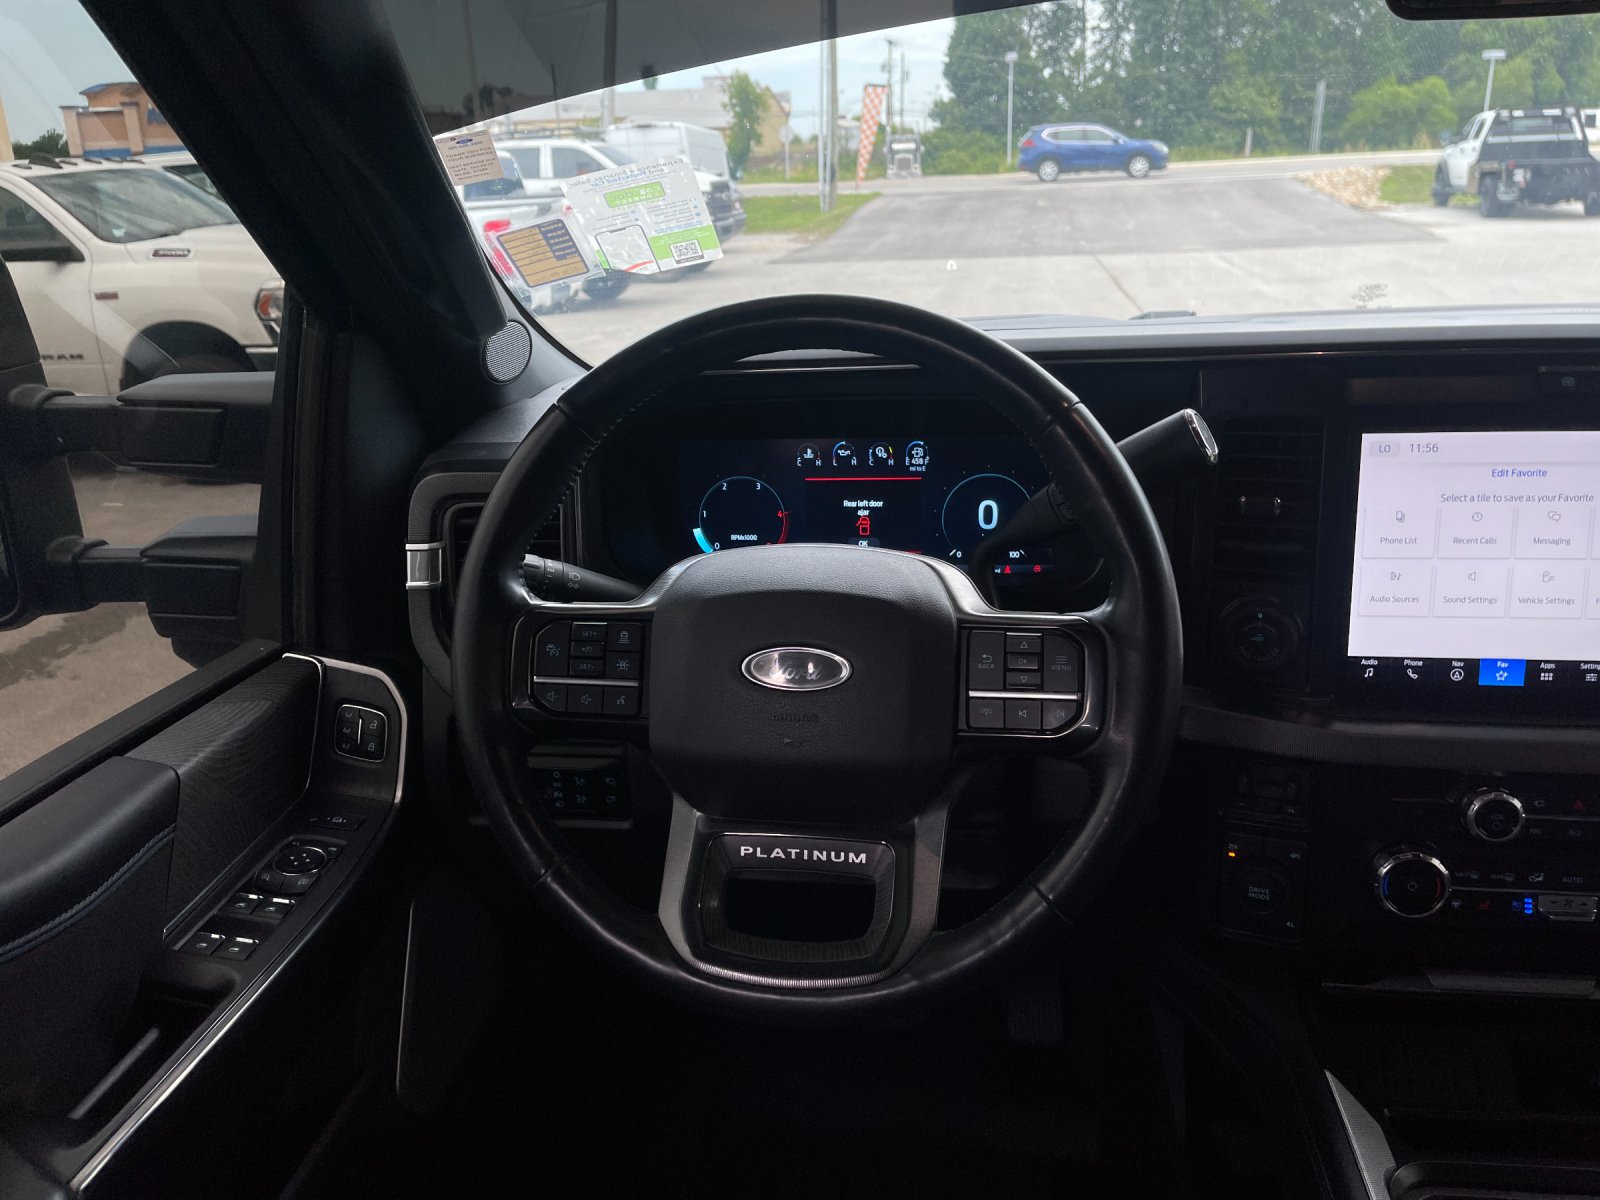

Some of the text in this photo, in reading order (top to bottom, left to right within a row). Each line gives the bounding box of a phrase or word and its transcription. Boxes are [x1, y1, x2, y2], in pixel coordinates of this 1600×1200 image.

[1379, 444, 1391, 453] LO
[1409, 443, 1439, 453] 11:56
[1492, 469, 1547, 478] Edit Favorite
[1441, 494, 1467, 502] Select
[1477, 494, 1491, 502] tile
[1537, 496, 1556, 505] your
[1558, 494, 1594, 503] Favorite
[978, 500, 998, 530] 0
[1533, 537, 1571, 546] Messaging
[1443, 595, 1497, 605] Sound Settings
[1518, 596, 1575, 606] Vehicle Settings
[740, 846, 866, 864] PLATINUM
